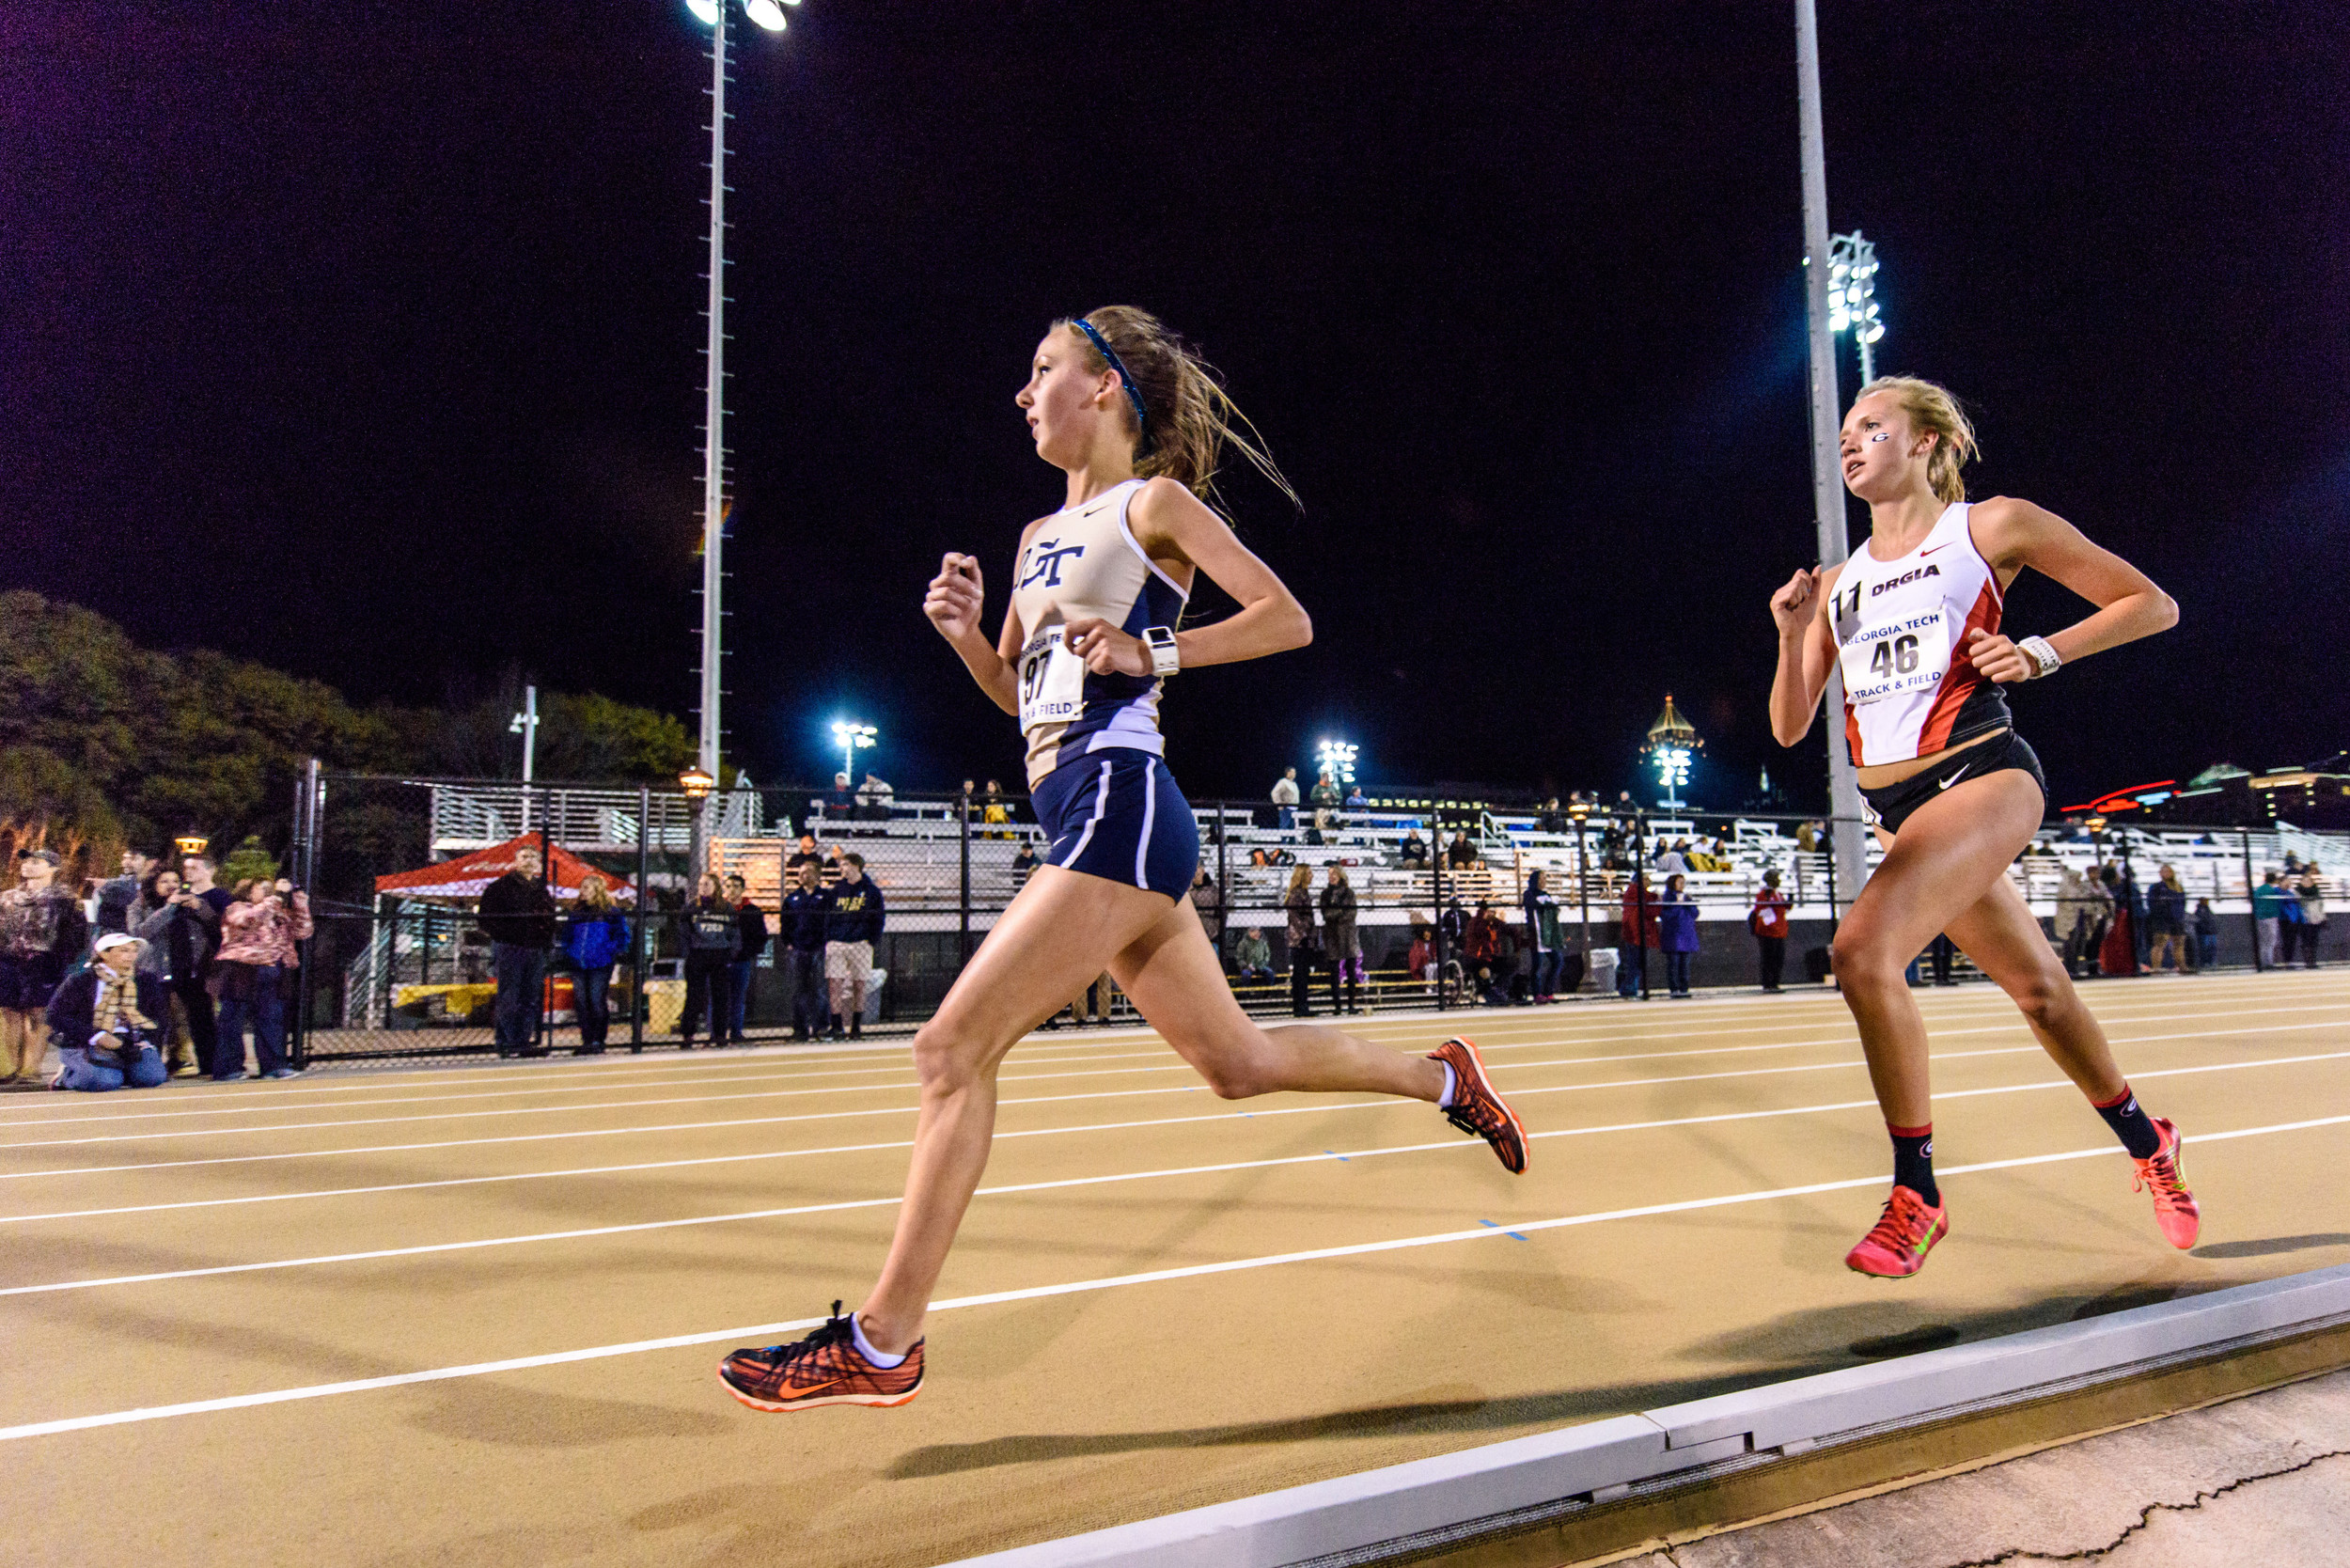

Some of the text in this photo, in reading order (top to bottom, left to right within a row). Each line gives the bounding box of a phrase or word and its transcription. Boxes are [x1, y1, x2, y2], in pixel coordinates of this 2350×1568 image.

[1872, 564, 1940, 597] ORGIA
[1831, 580, 1862, 622] 11
[1846, 614, 1939, 646] GEORGIA TECH
[1870, 635, 1919, 678] 46
[1025, 649, 1053, 706] 97
[1855, 671, 1941, 699] TRACK & FIELD
[1039, 702, 1072, 715] FIELD
